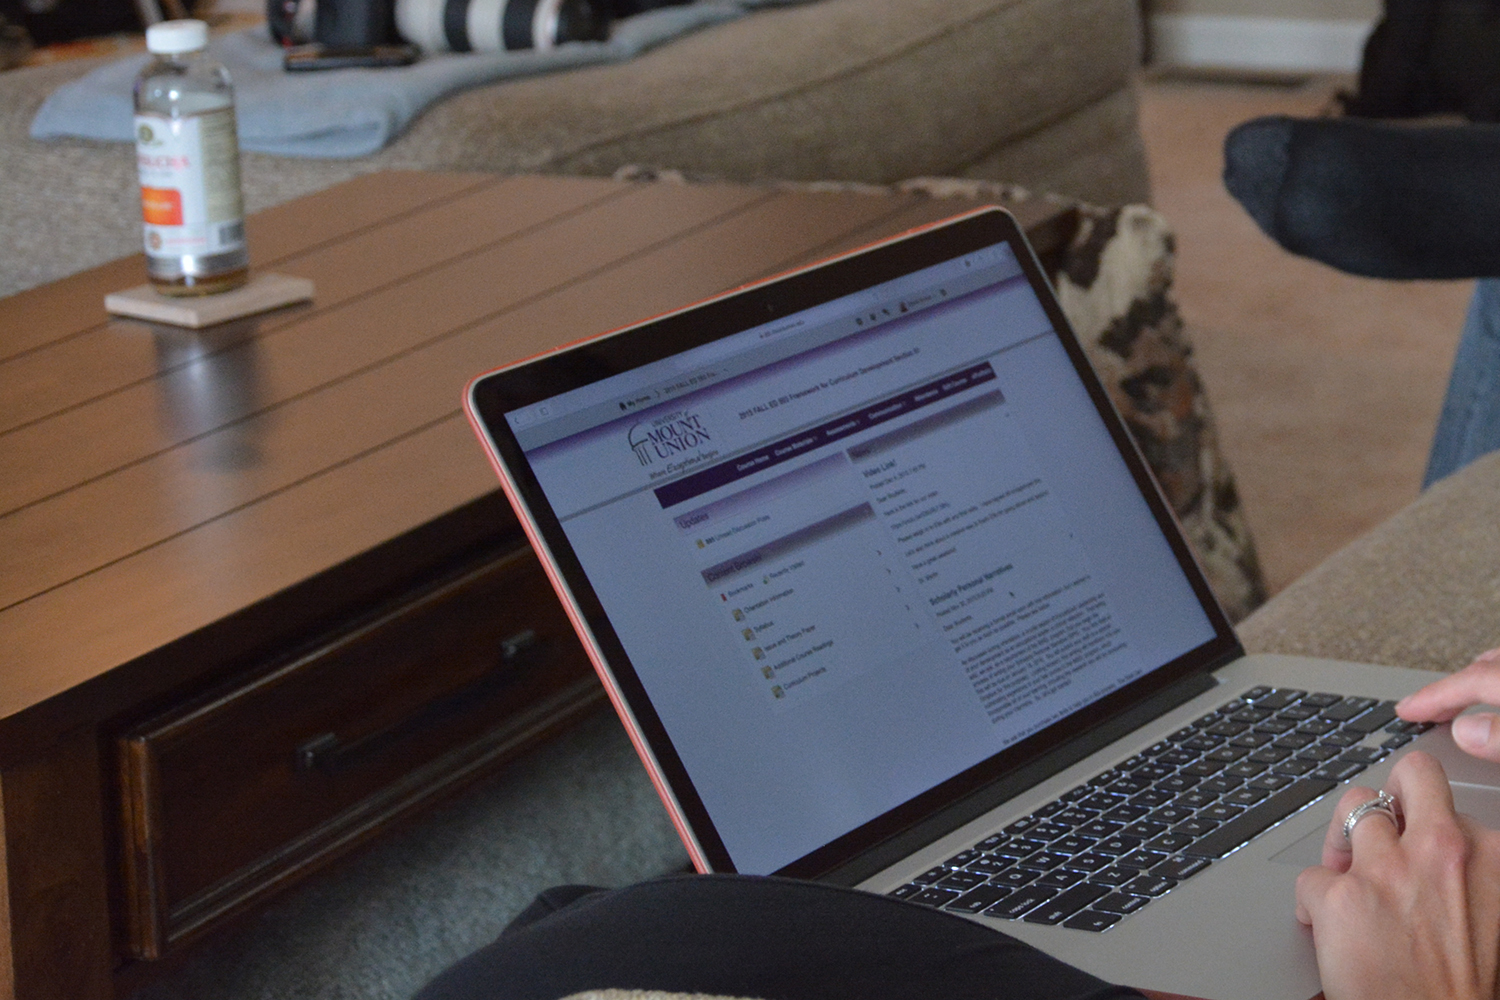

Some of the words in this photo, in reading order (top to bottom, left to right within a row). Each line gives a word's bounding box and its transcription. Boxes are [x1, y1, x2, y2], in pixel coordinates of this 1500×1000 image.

[787, 383, 821, 401] Framework
[826, 368, 860, 386] Curriculum
[856, 355, 895, 376] Development
[649, 409, 685, 428] UNIVERSITY
[645, 413, 706, 446] MOUNT
[652, 426, 713, 461] UNION
[772, 443, 793, 457] Course
[734, 457, 757, 472] Course
[753, 452, 771, 465] Home
[861, 465, 882, 479] Video
[878, 457, 898, 472] Link!
[677, 510, 711, 531] Updates
[705, 562, 737, 583] Content
[731, 550, 764, 572] Browser
[767, 565, 791, 581] Recently
[726, 580, 755, 598] Bookmarks
[927, 587, 959, 607] Scholarly
[955, 574, 985, 594] Personal
[981, 561, 1014, 581] Narratives
[742, 597, 770, 614] Orientation
[767, 586, 795, 603] Information
[752, 618, 775, 634] Syllabus
[784, 628, 804, 643] Theory
[772, 655, 797, 671] Additional
[794, 647, 814, 661] Course
[810, 637, 836, 654] Readings
[781, 673, 809, 691] Curriculum
